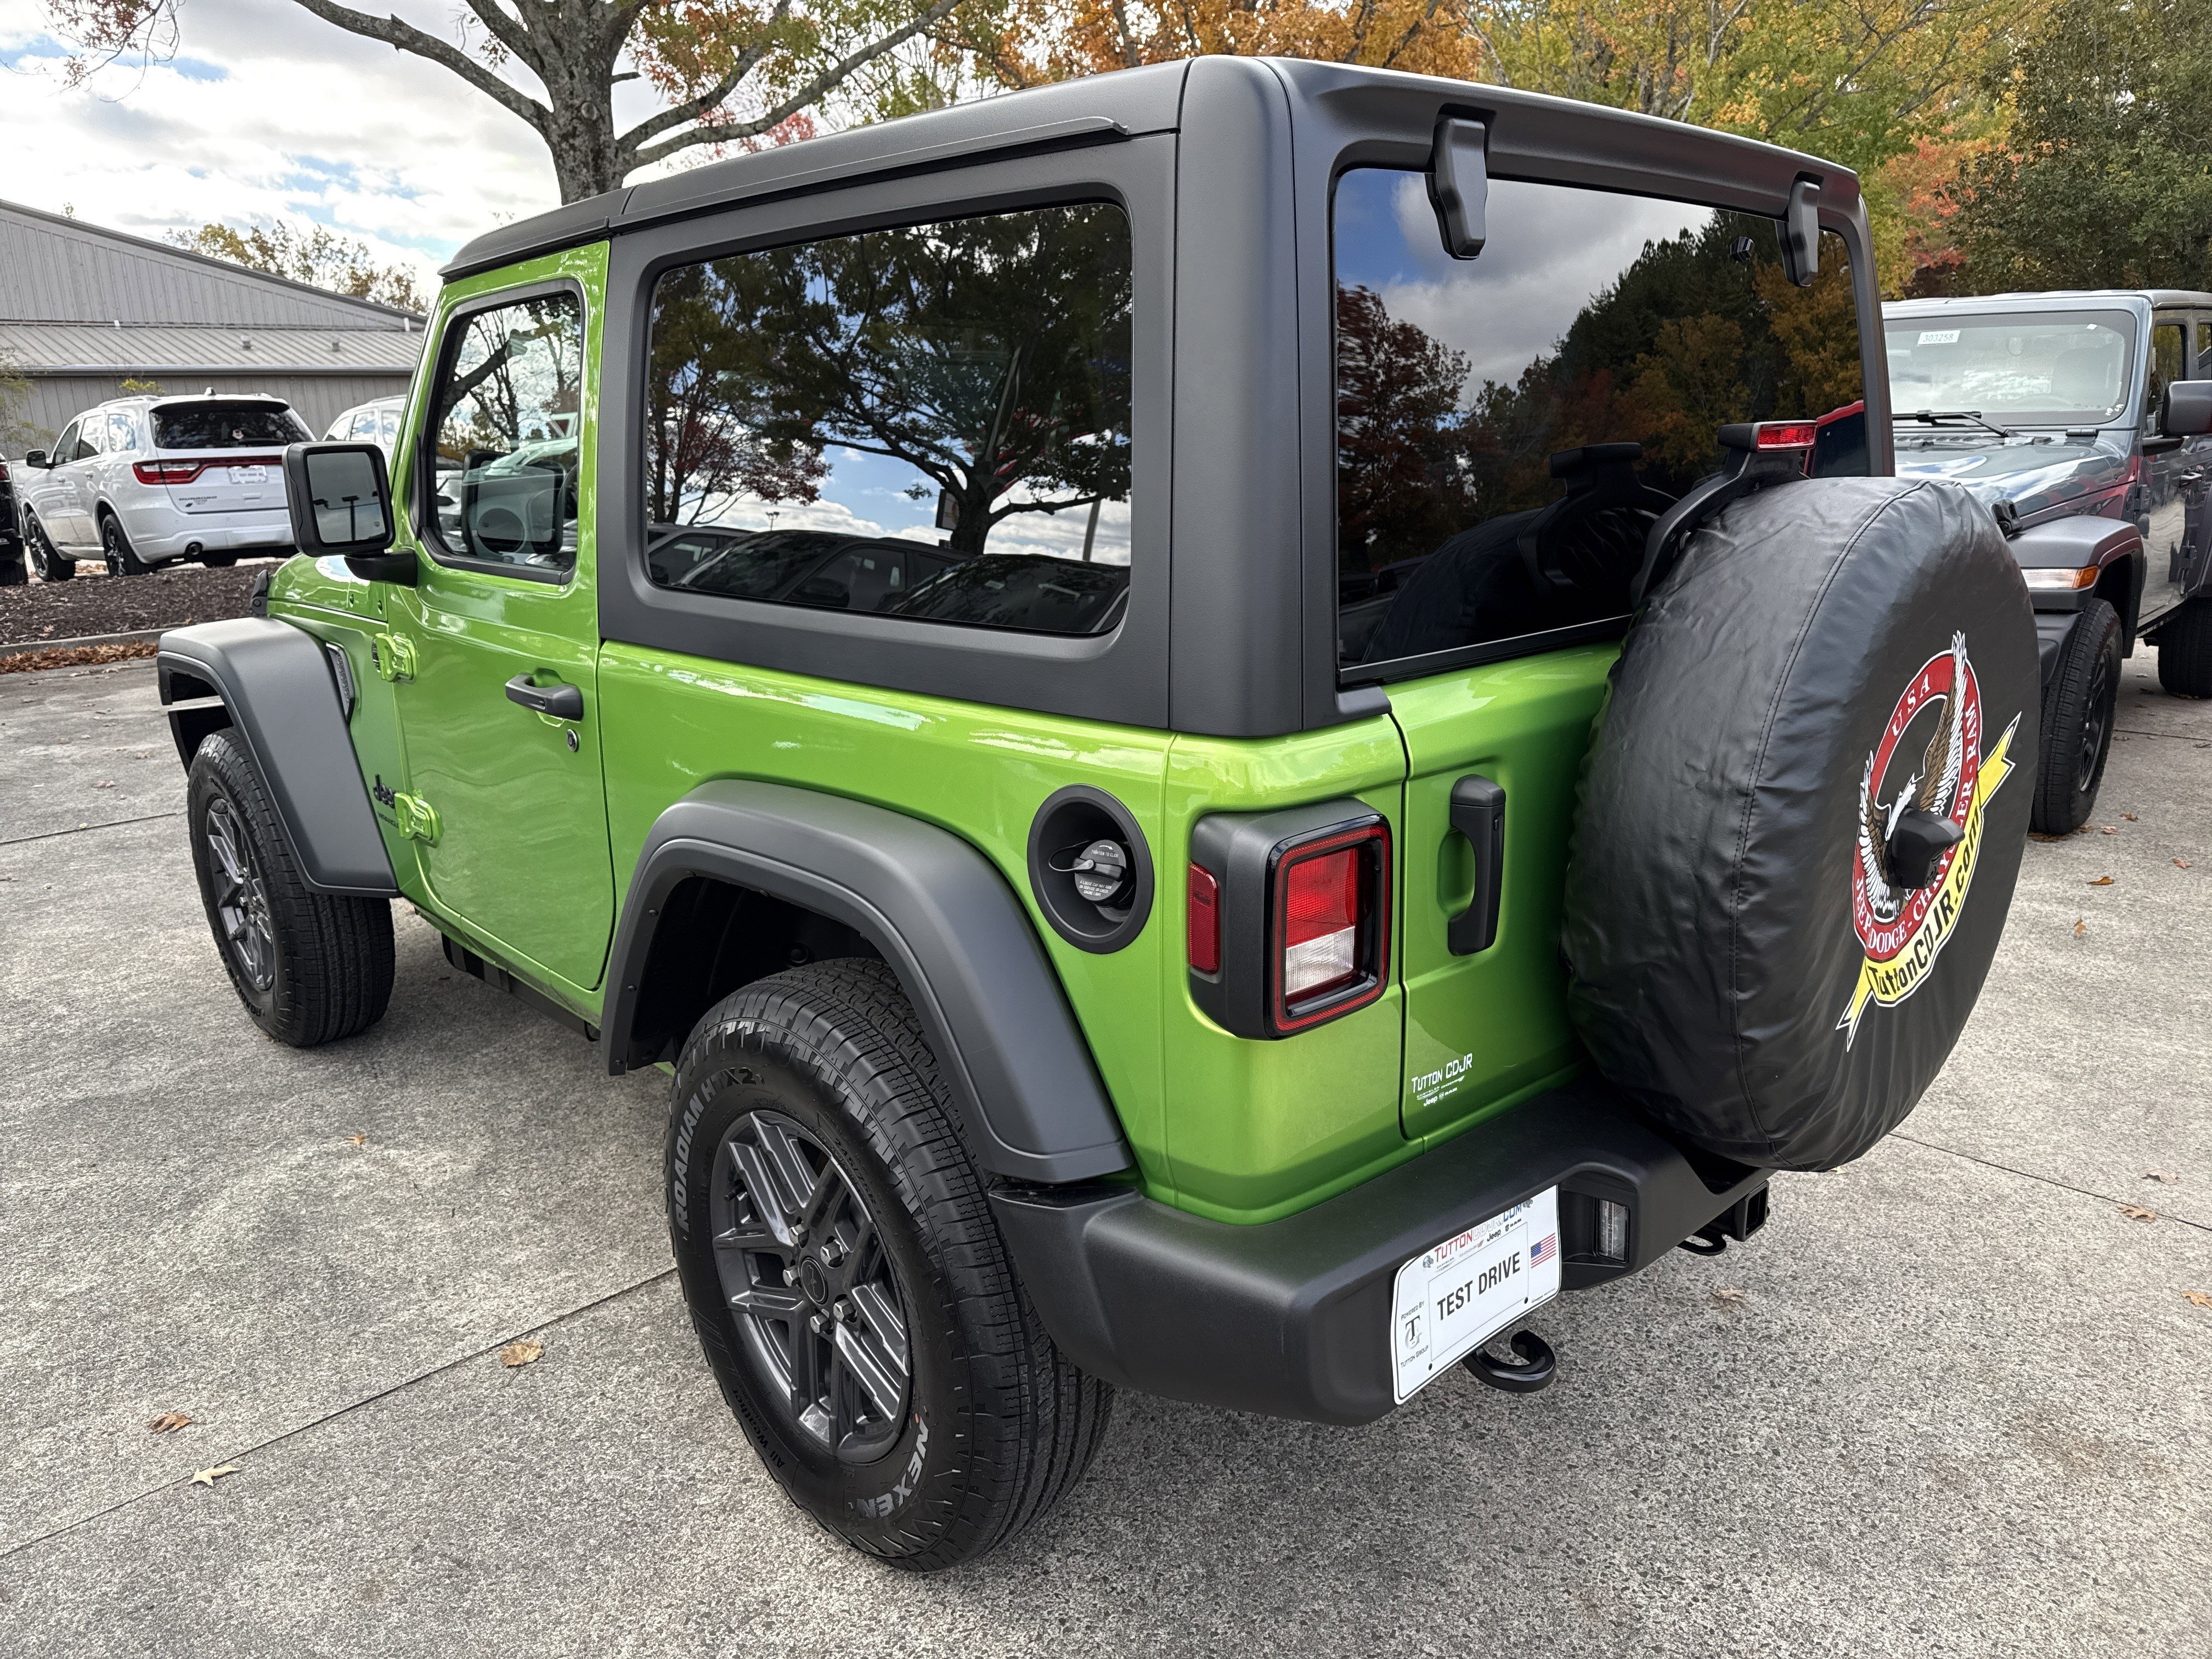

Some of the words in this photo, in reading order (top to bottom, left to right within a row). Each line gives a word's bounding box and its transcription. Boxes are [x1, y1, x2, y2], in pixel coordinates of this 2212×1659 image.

[1892, 673, 1931, 736] USA
[1868, 921, 1907, 953] DODGE
[1412, 1068, 1443, 1093] TUTTON
[1446, 1053, 1472, 1079] CDJR
[674, 1092, 705, 1233] ROADIAN
[1487, 1229, 1502, 1242] Jeep
[1437, 1280, 1473, 1321] TEST
[1479, 1251, 1521, 1295] DRIVE
[856, 1416, 929, 1513] NEXEN
